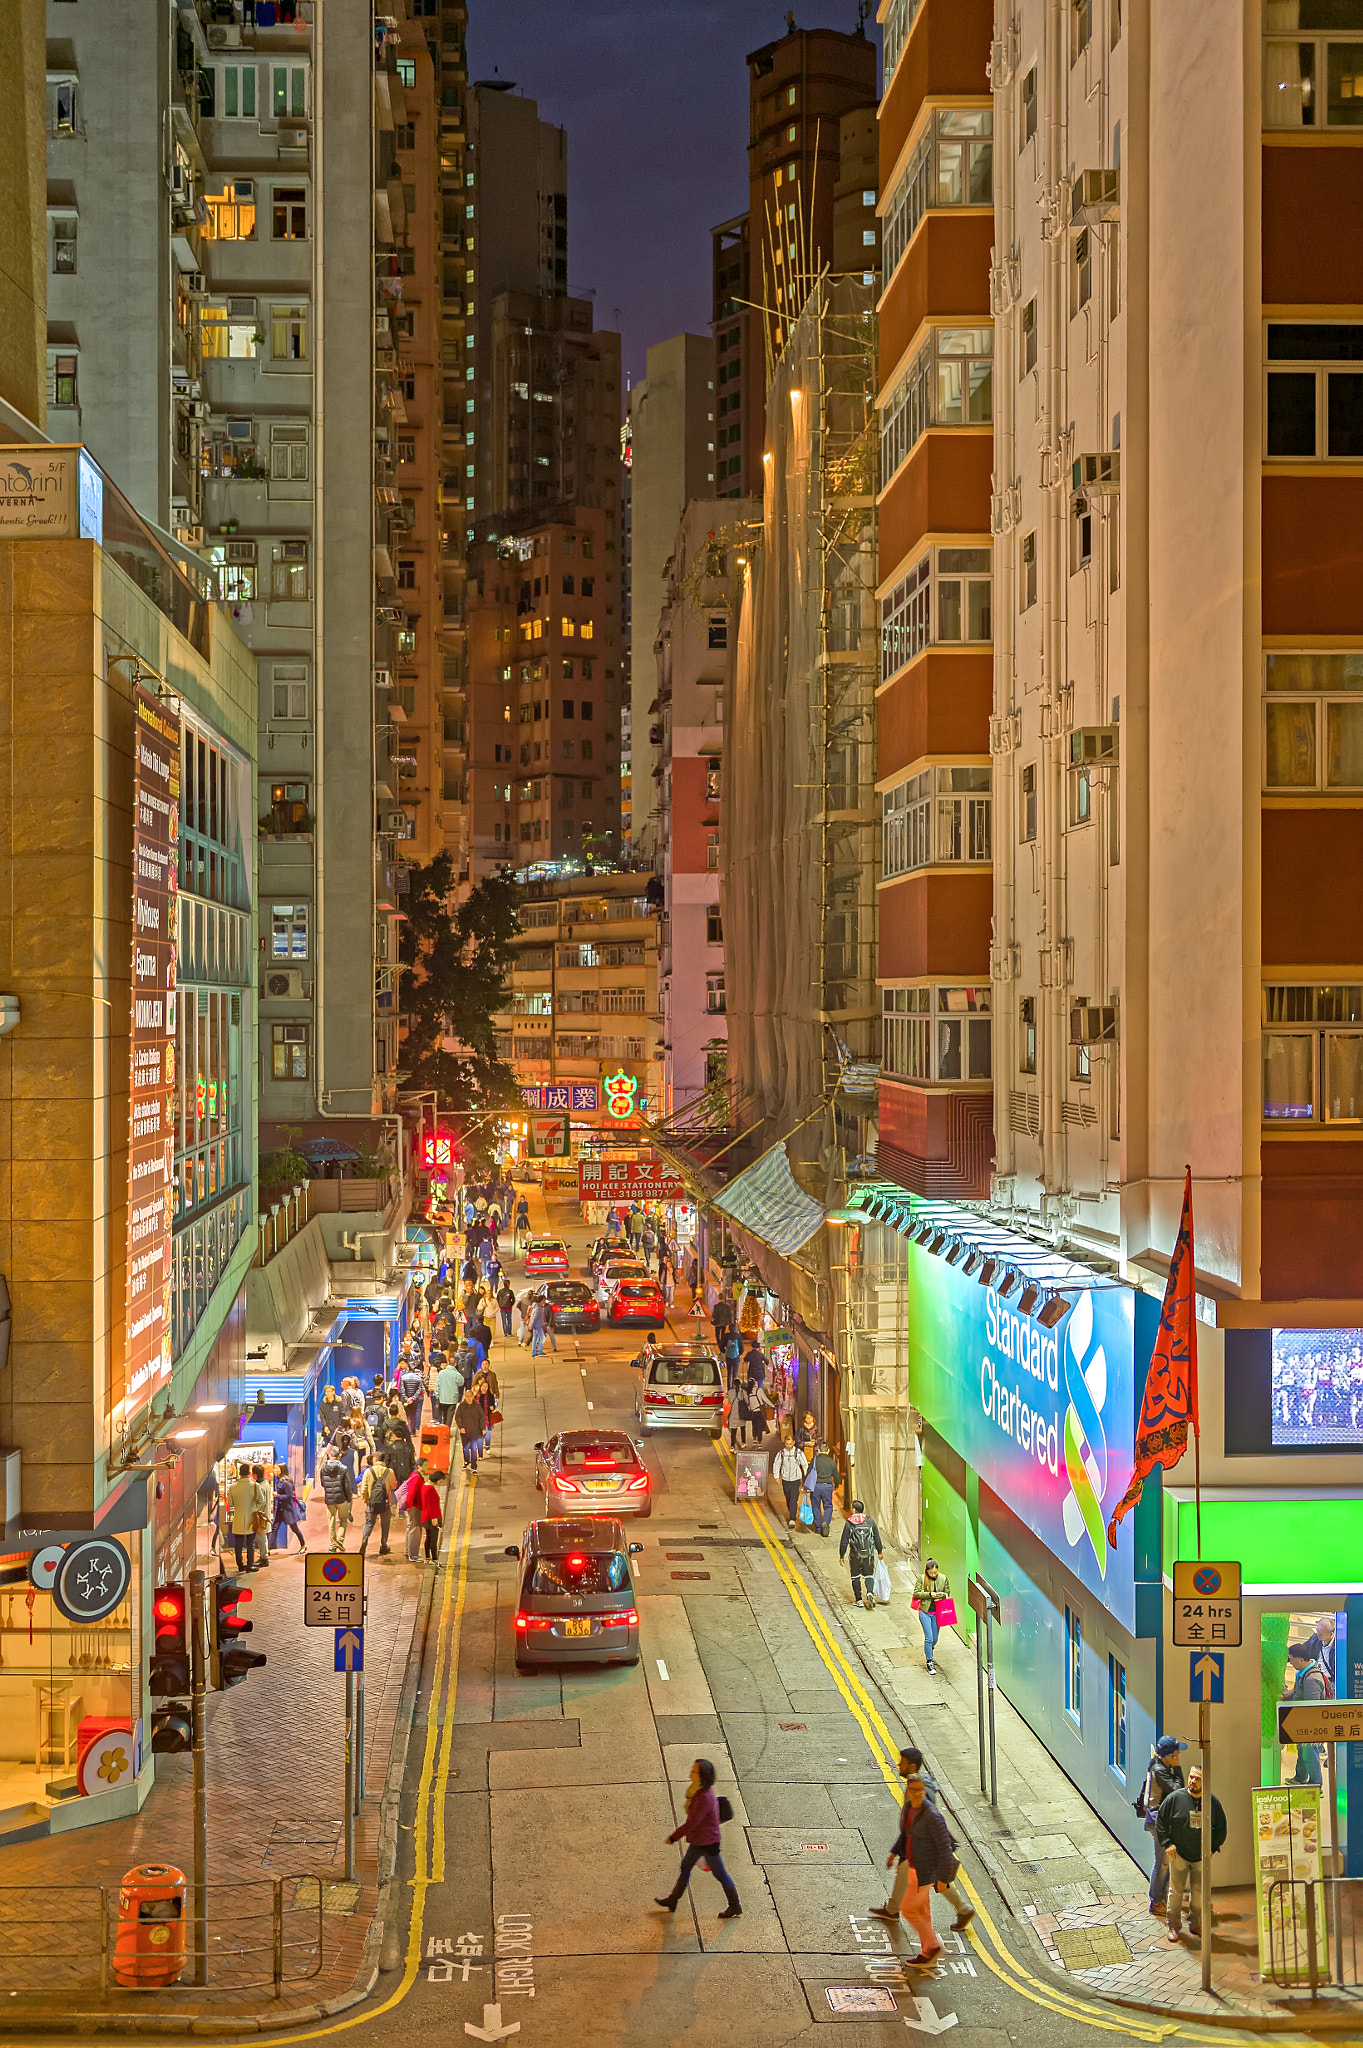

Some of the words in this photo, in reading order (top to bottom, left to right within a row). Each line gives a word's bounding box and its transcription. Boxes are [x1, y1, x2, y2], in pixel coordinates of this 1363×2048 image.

[48, 462, 66, 472] 5/F
[138, 698, 163, 734] International
[137, 898, 159, 932] MyHouse
[582, 1182, 600, 1190] HOI
[602, 1182, 620, 1190] KEE
[622, 1181, 680, 1189] STATIONERY
[593, 1190, 617, 1199] TEL:
[618, 1190, 644, 1199] 3188
[985, 1285, 1059, 1393] Standard
[980, 1355, 1059, 1478] Chartered
[312, 1590, 332, 1602] 24
[335, 1590, 356, 1602] hrs
[316, 1605, 350, 1621] 全日
[1182, 1604, 1204, 1618] 24
[1208, 1605, 1232, 1618] hrs
[1187, 1622, 1226, 1640] 全日
[1321, 1710, 1363, 1720] Queen's
[1333, 1724, 1361, 1738] 皇后
[495, 1913, 534, 1953] LOOK
[848, 1914, 893, 1953] LEFT
[496, 1954, 536, 1998] RIGHT
[860, 1955, 912, 1993] LOOK
